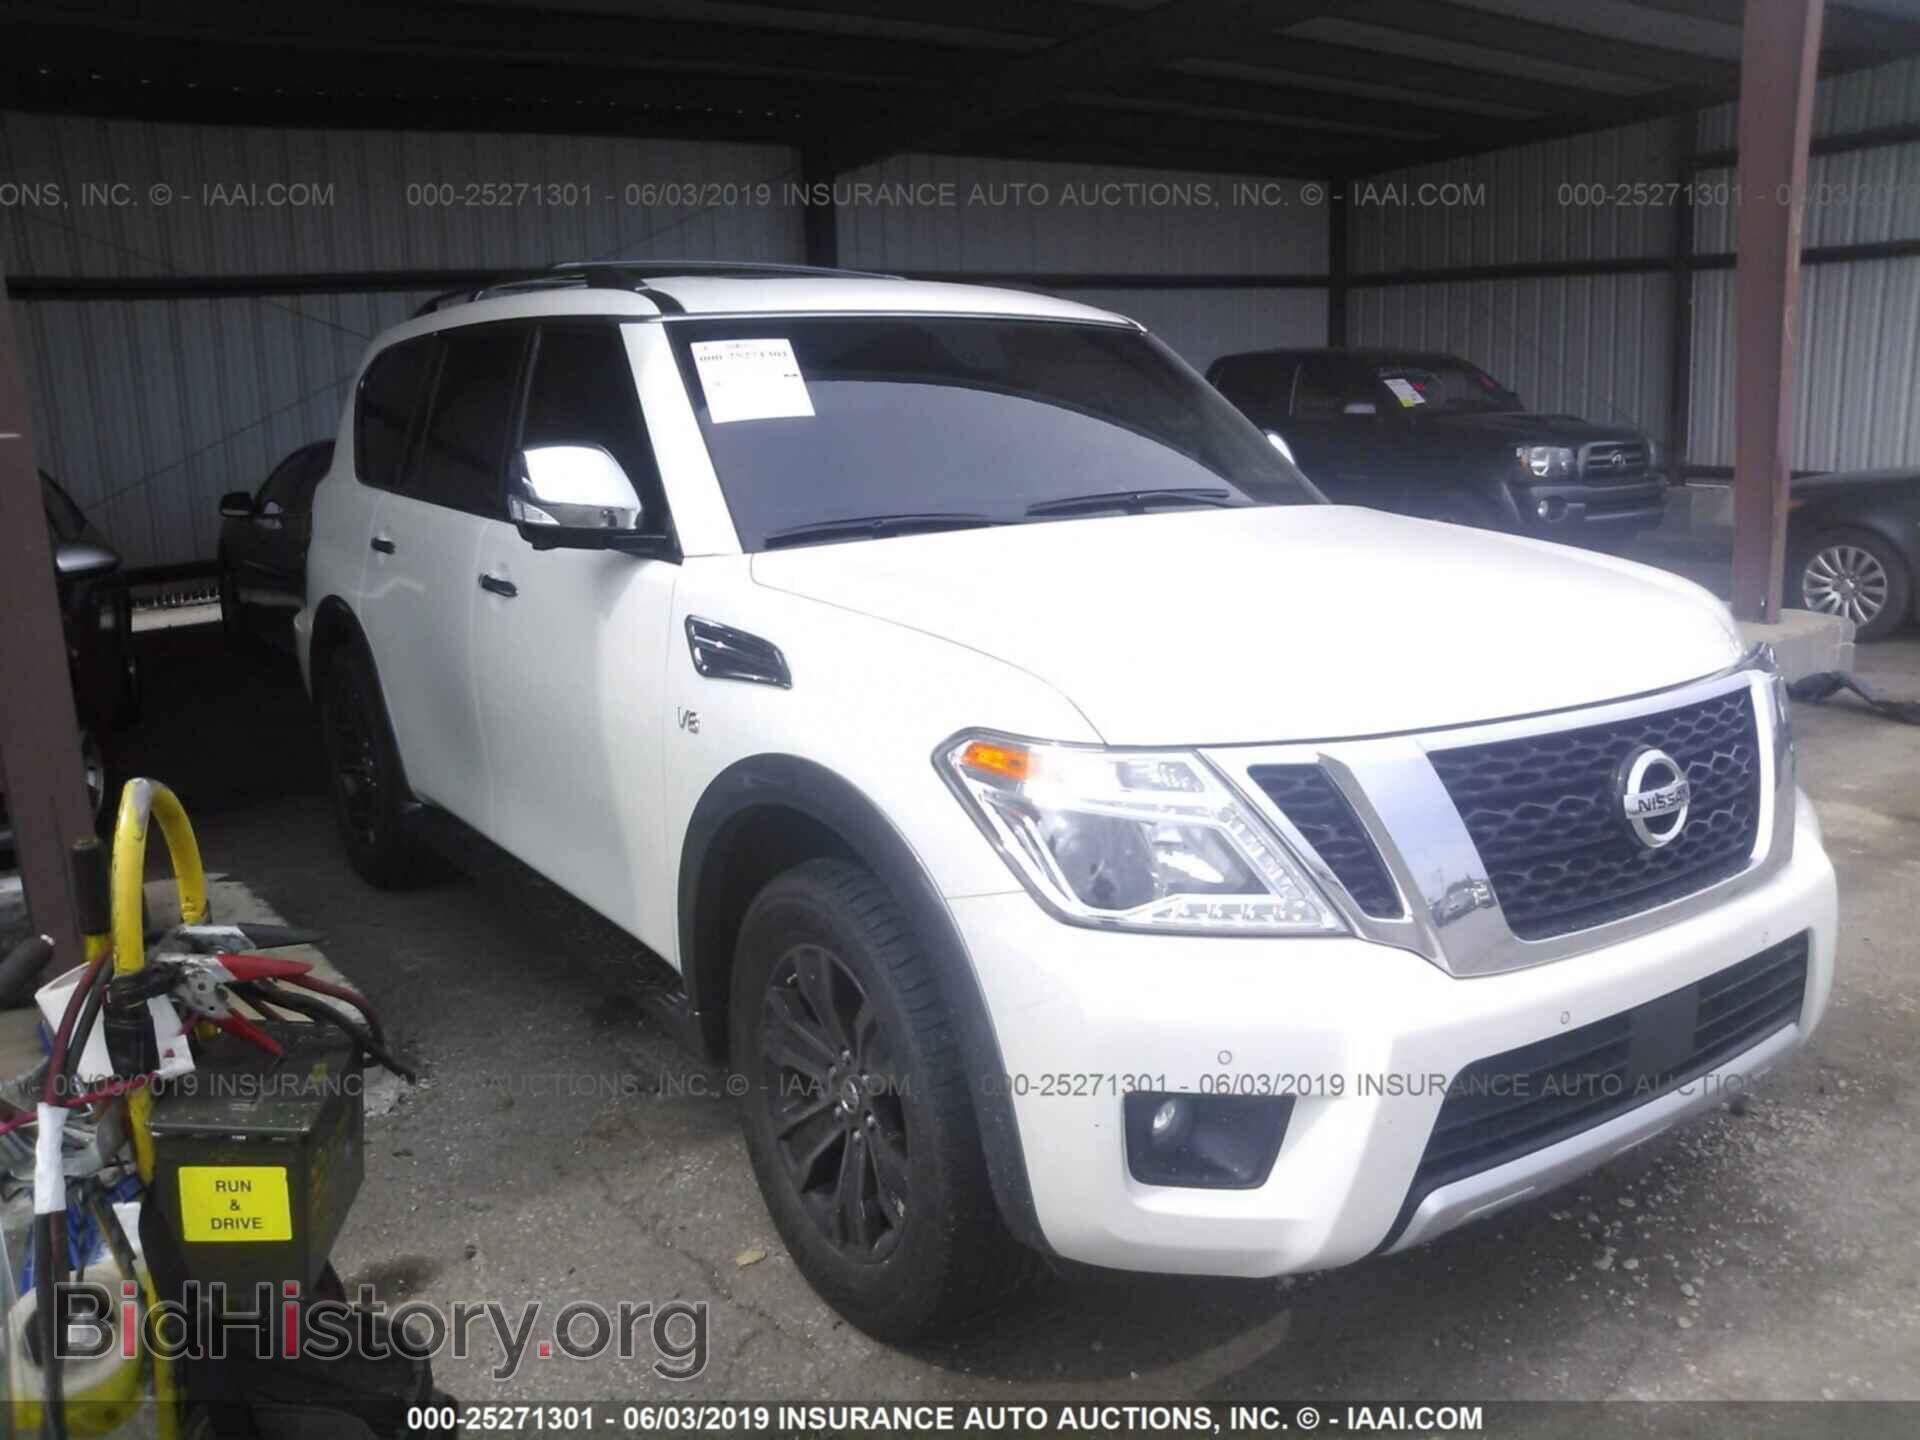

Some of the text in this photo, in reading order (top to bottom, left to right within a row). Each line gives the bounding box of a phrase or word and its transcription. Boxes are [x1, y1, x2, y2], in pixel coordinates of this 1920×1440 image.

[215, 1180, 252, 1193] RUN
[229, 1199, 241, 1212] &
[210, 1216, 264, 1230] DRIVE
